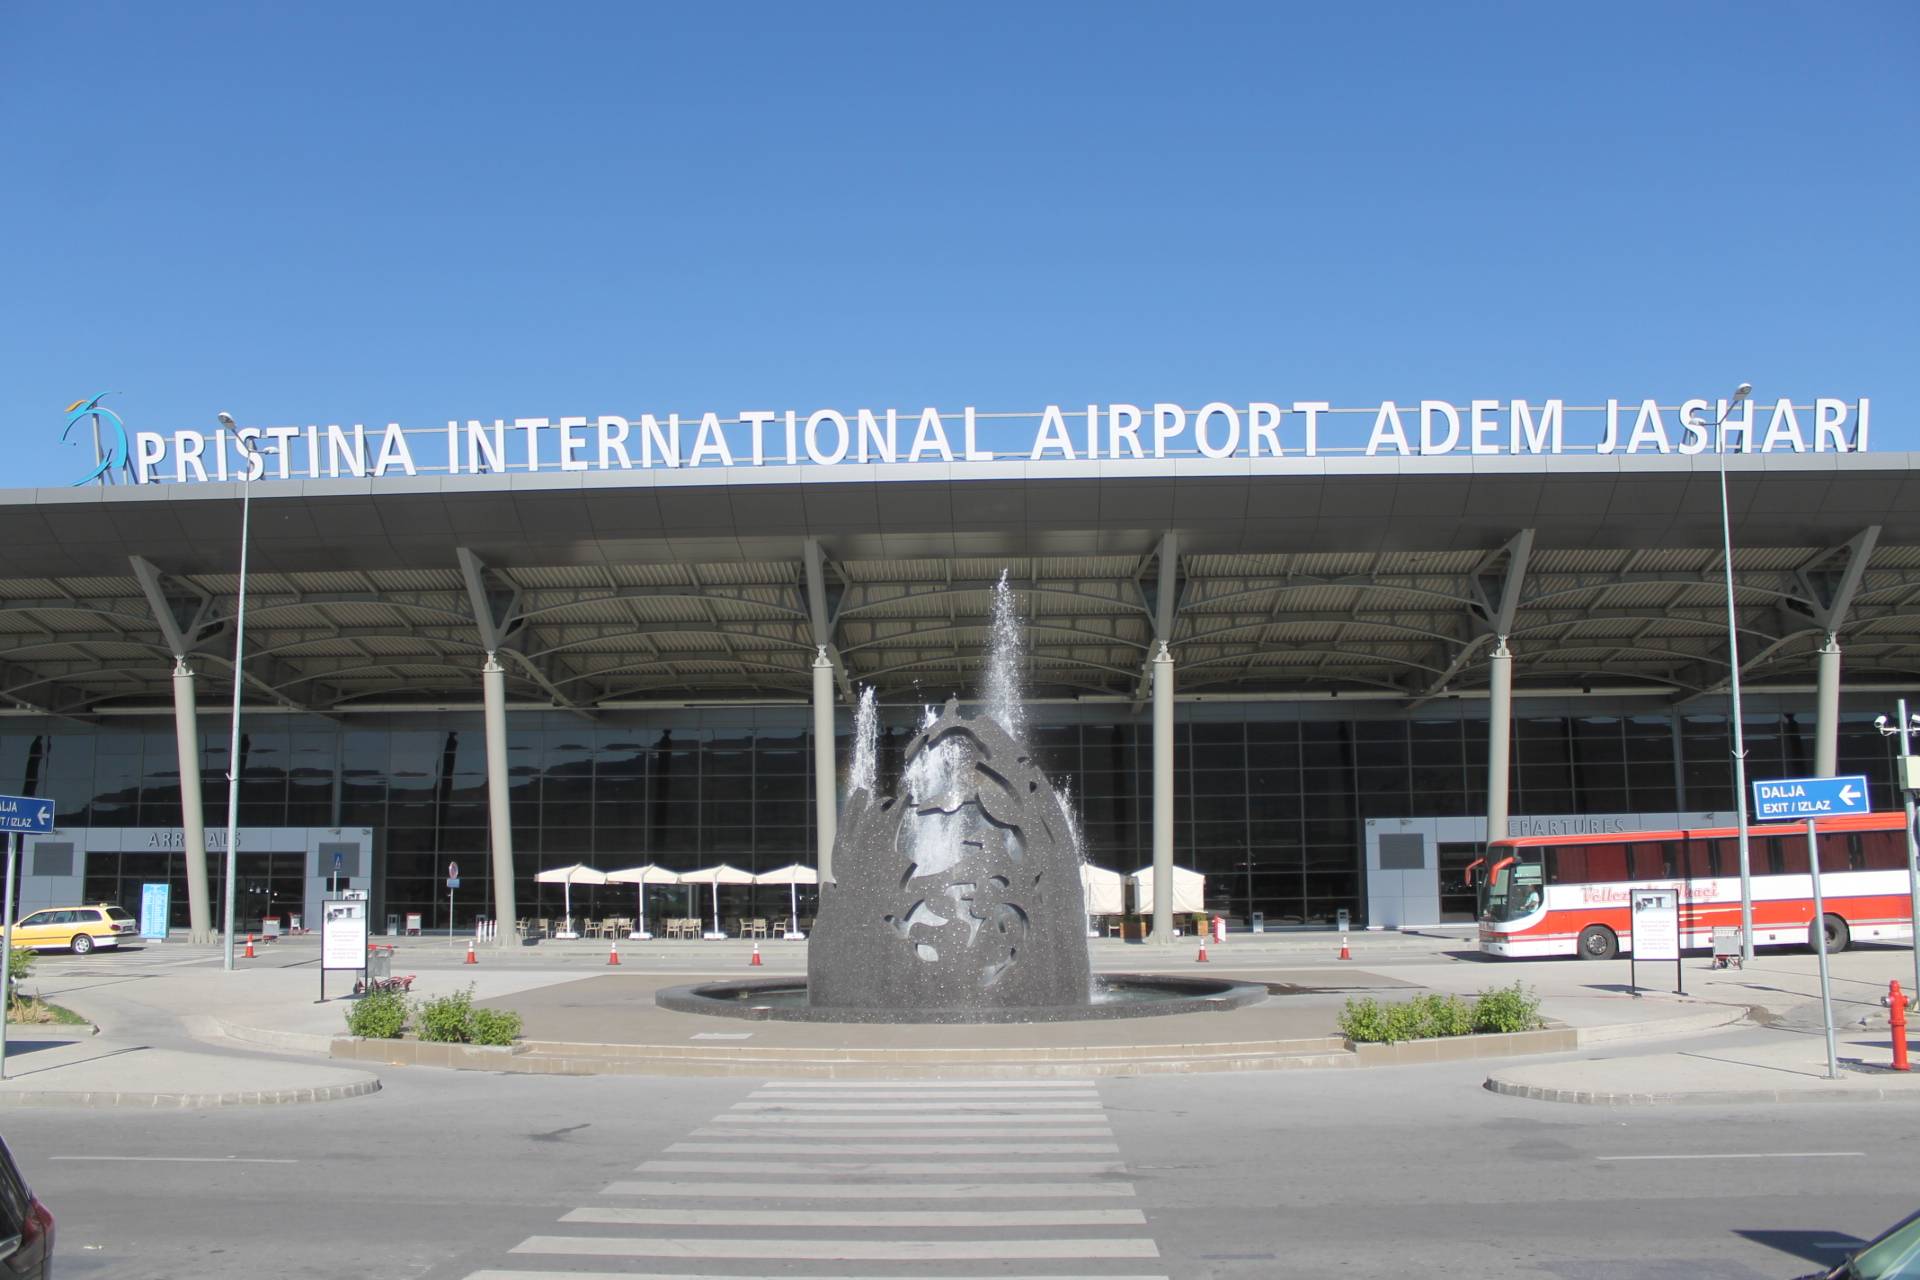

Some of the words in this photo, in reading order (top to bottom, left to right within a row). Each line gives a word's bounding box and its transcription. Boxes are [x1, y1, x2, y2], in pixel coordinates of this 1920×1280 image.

[136, 423, 417, 484] PRISTINA
[447, 406, 994, 474] INTERNATIONAL
[1030, 401, 1329, 460] AIRPORT
[1364, 399, 1563, 457] ADEM
[1596, 398, 1870, 455] JASHARI
[1761, 785, 1806, 799] DALJA
[0, 800, 18, 813] LJA
[1763, 802, 1789, 814] EXIT
[1798, 800, 1832, 812] IZLAZ
[1507, 818, 1625, 837] EPARTURES
[148, 831, 241, 848] ARRALS
